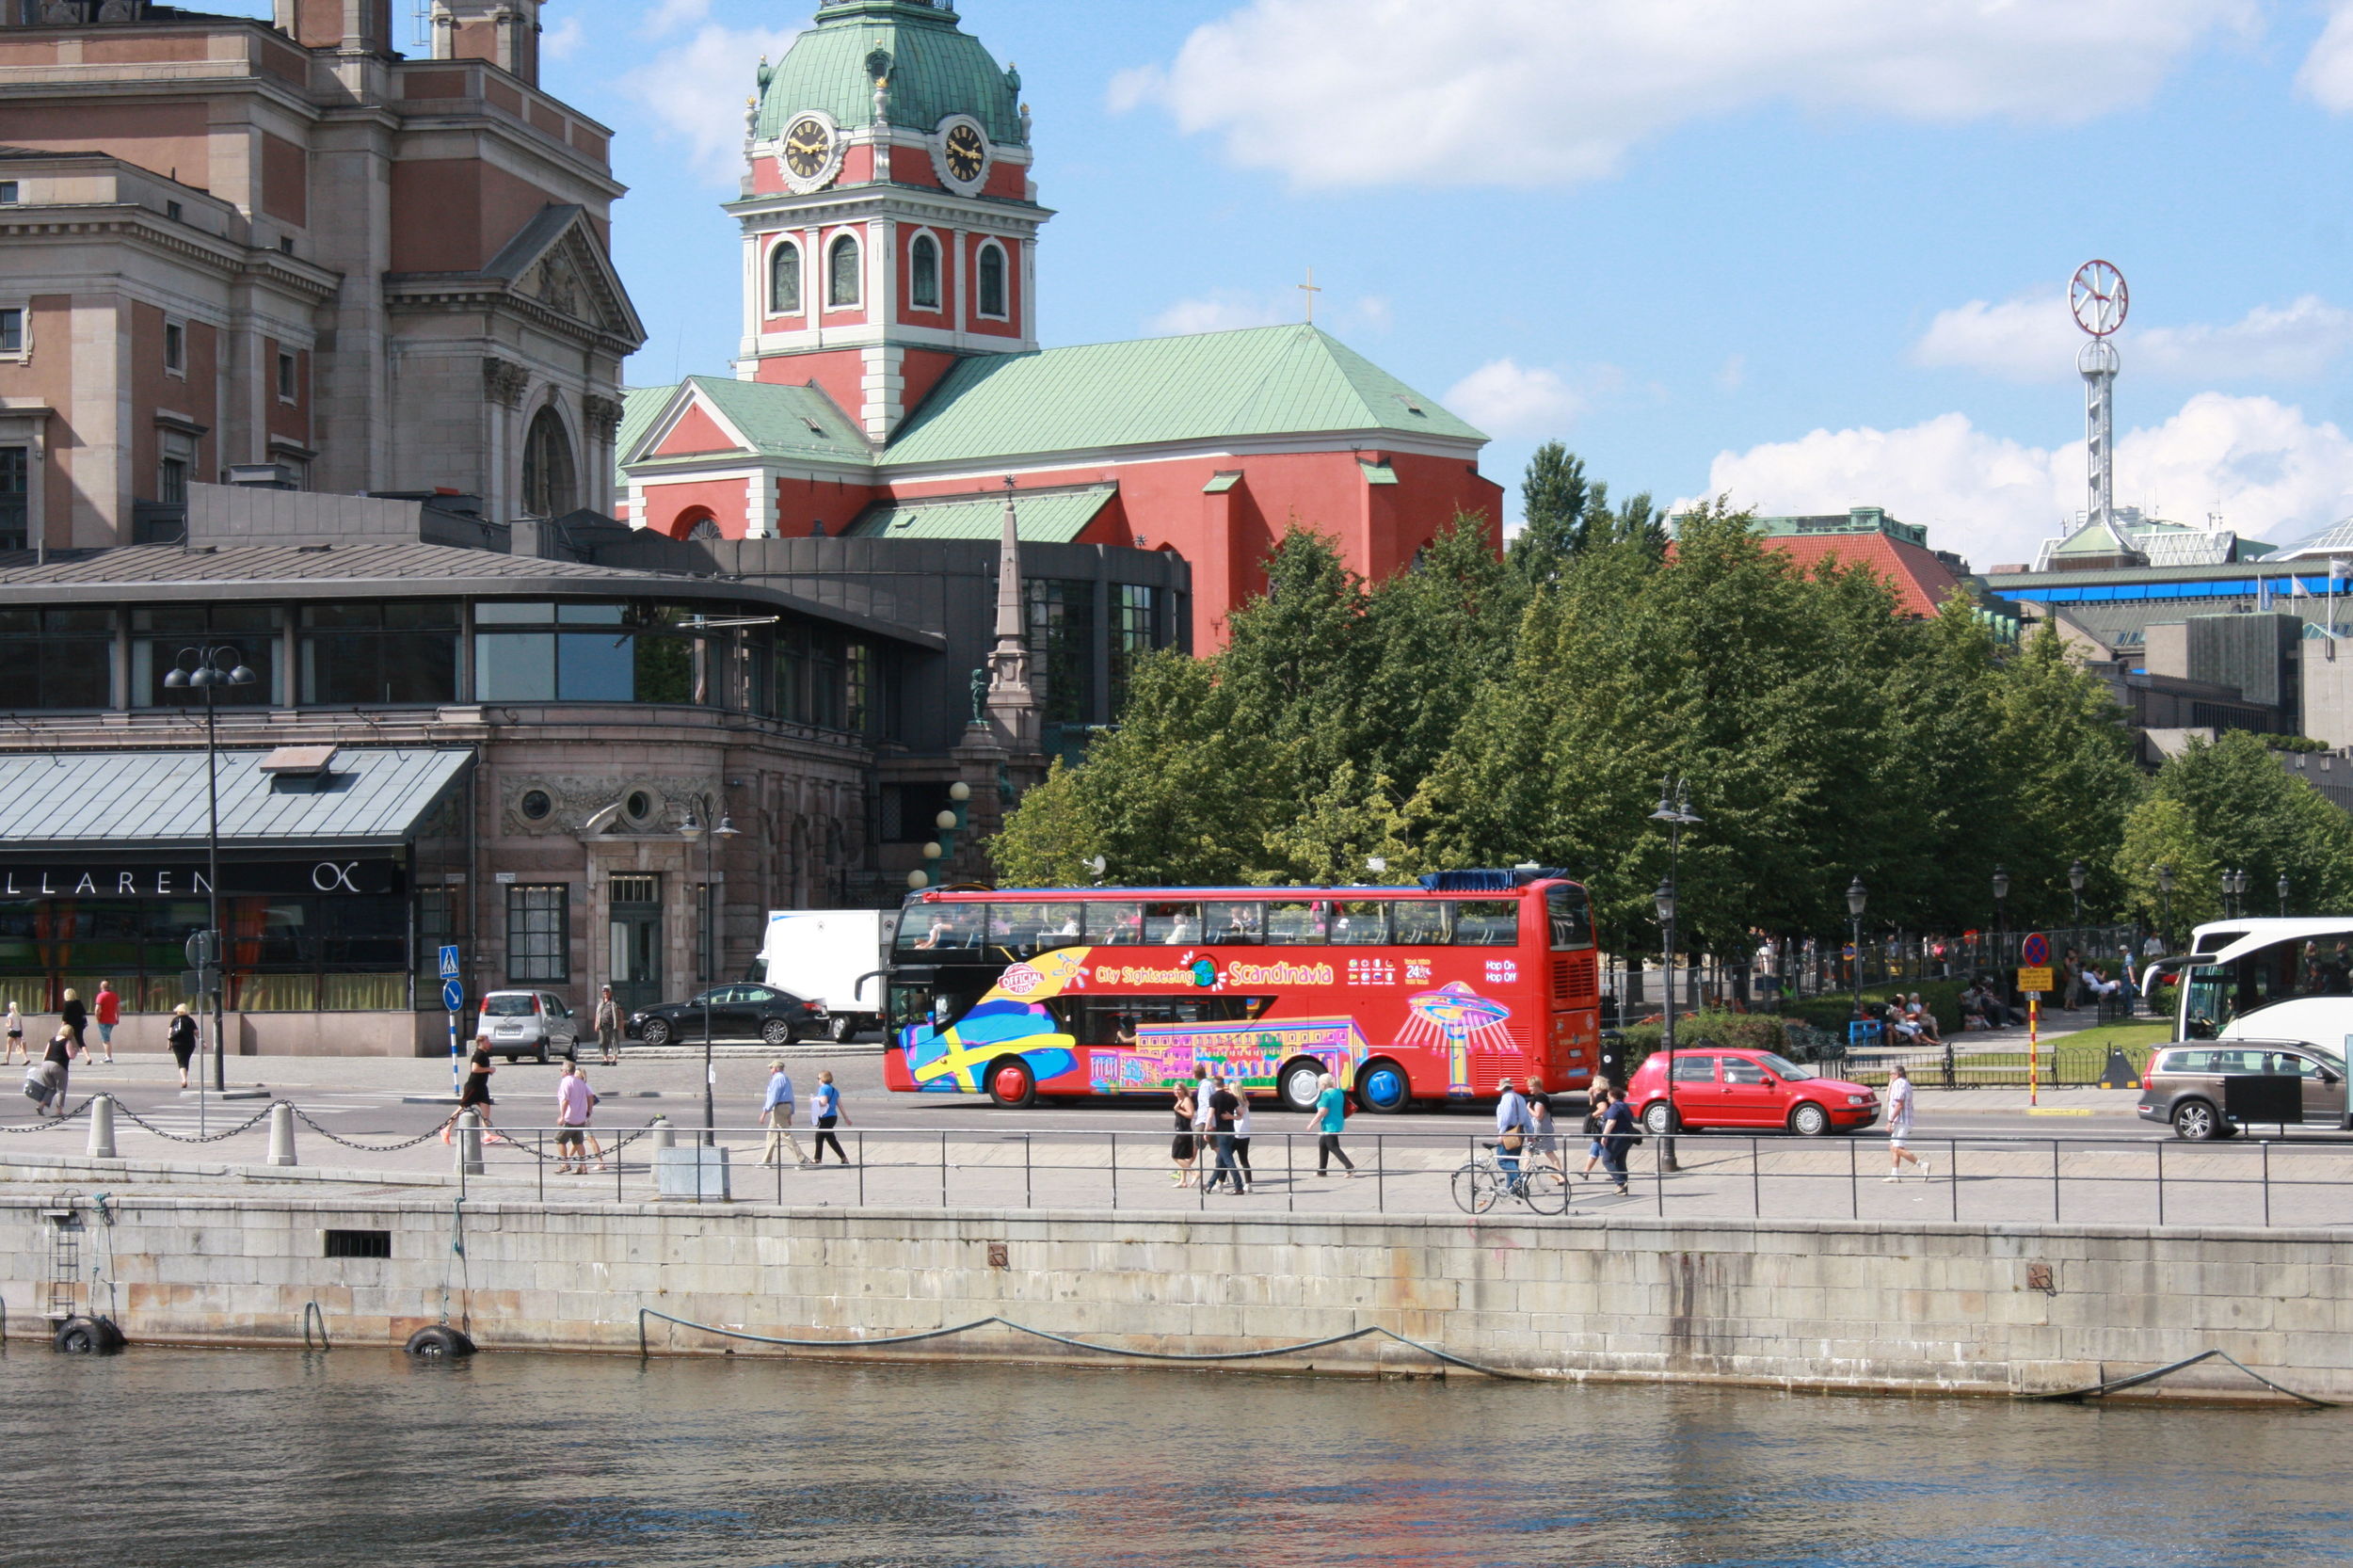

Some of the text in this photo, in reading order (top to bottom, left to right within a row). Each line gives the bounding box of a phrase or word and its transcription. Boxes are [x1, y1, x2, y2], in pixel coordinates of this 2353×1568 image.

[1485, 960, 1515, 970] Hop On
[1002, 973, 1042, 987] OFFICIAL
[1096, 966, 1195, 986] City Sightseeing
[1228, 961, 1334, 986] Scandinavia
[1485, 971, 1516, 983] Hop Off
[1015, 984, 1033, 993] TOUR
